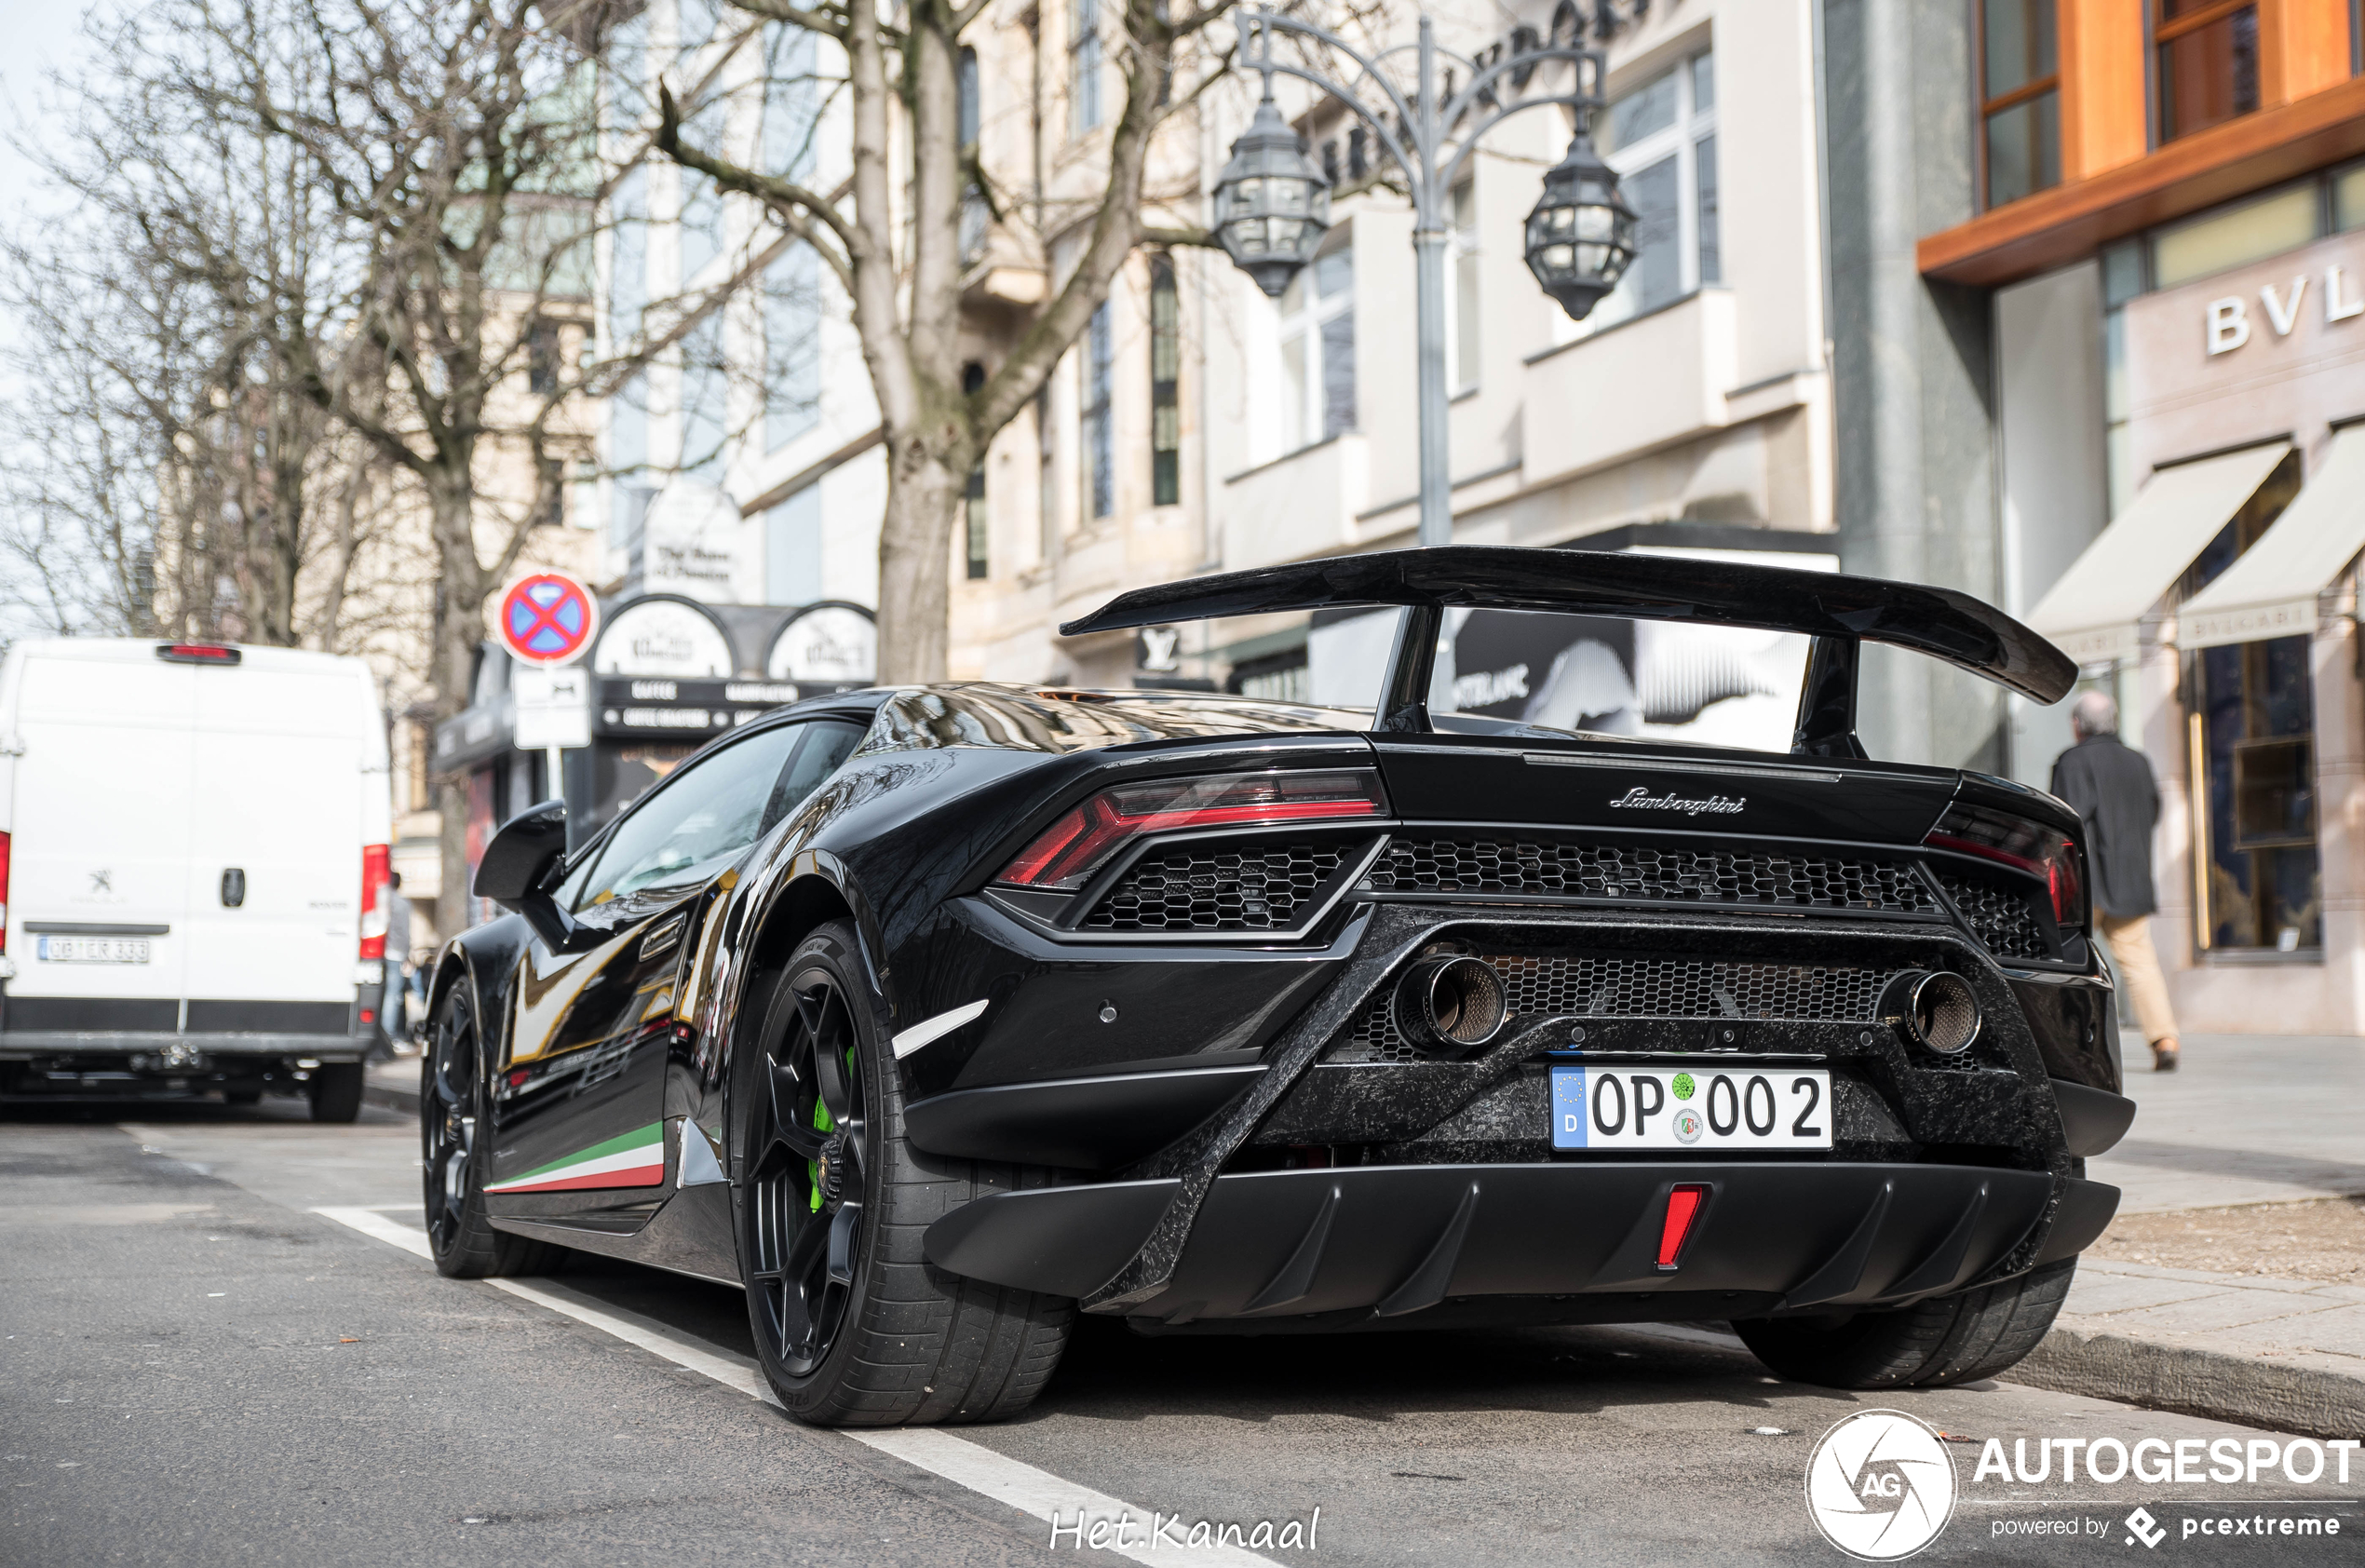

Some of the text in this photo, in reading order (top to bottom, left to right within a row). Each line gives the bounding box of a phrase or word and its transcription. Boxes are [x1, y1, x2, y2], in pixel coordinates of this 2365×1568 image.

[2207, 264, 2365, 355] BVL
[1610, 787, 1747, 817] Lamborghini
[1564, 1114, 1578, 1132] D
[1591, 1073, 1665, 1136] OP
